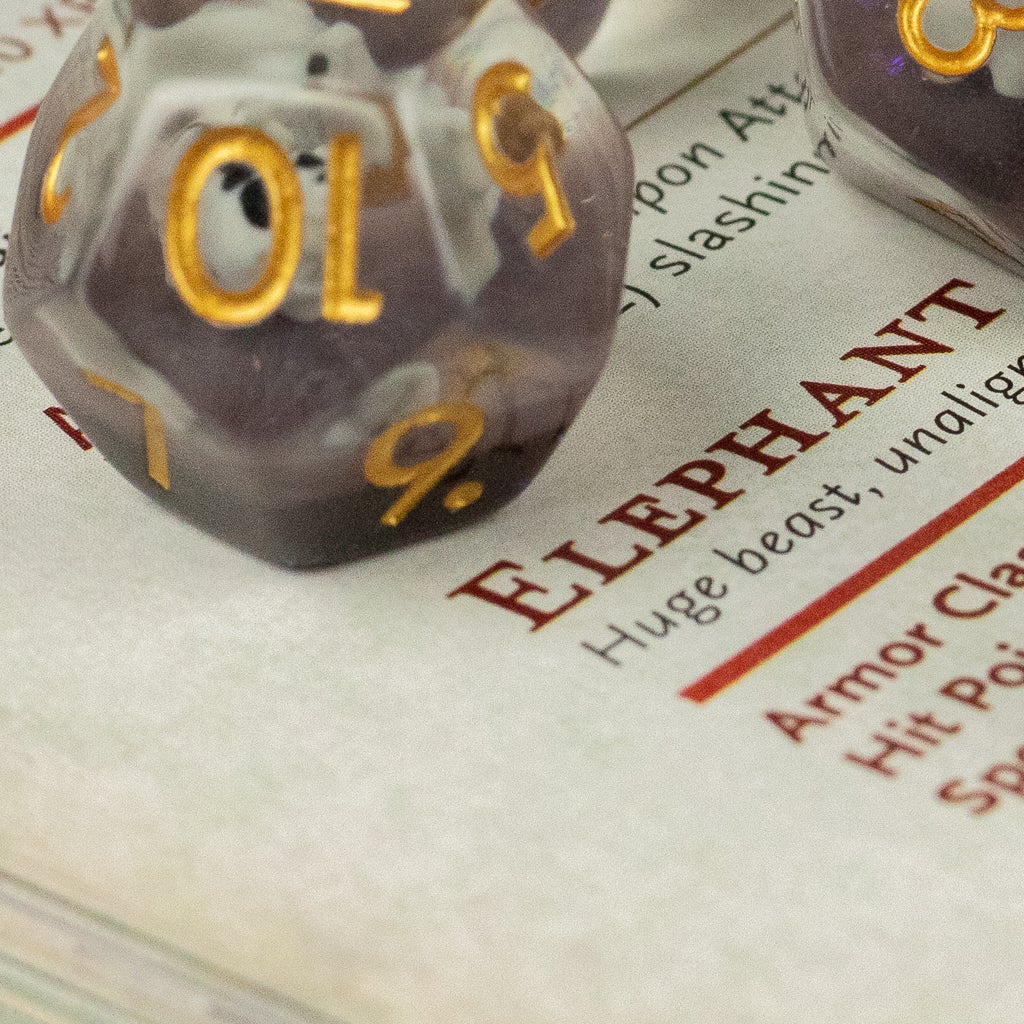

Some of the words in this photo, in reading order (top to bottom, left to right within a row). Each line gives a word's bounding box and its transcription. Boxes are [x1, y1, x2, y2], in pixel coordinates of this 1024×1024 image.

[447, 277, 1008, 632] ELEPHANT
[580, 576, 730, 670] Huge
[719, 480, 885, 576] beast,
[763, 618, 943, 745] Armor
[844, 709, 962, 779] Hit
